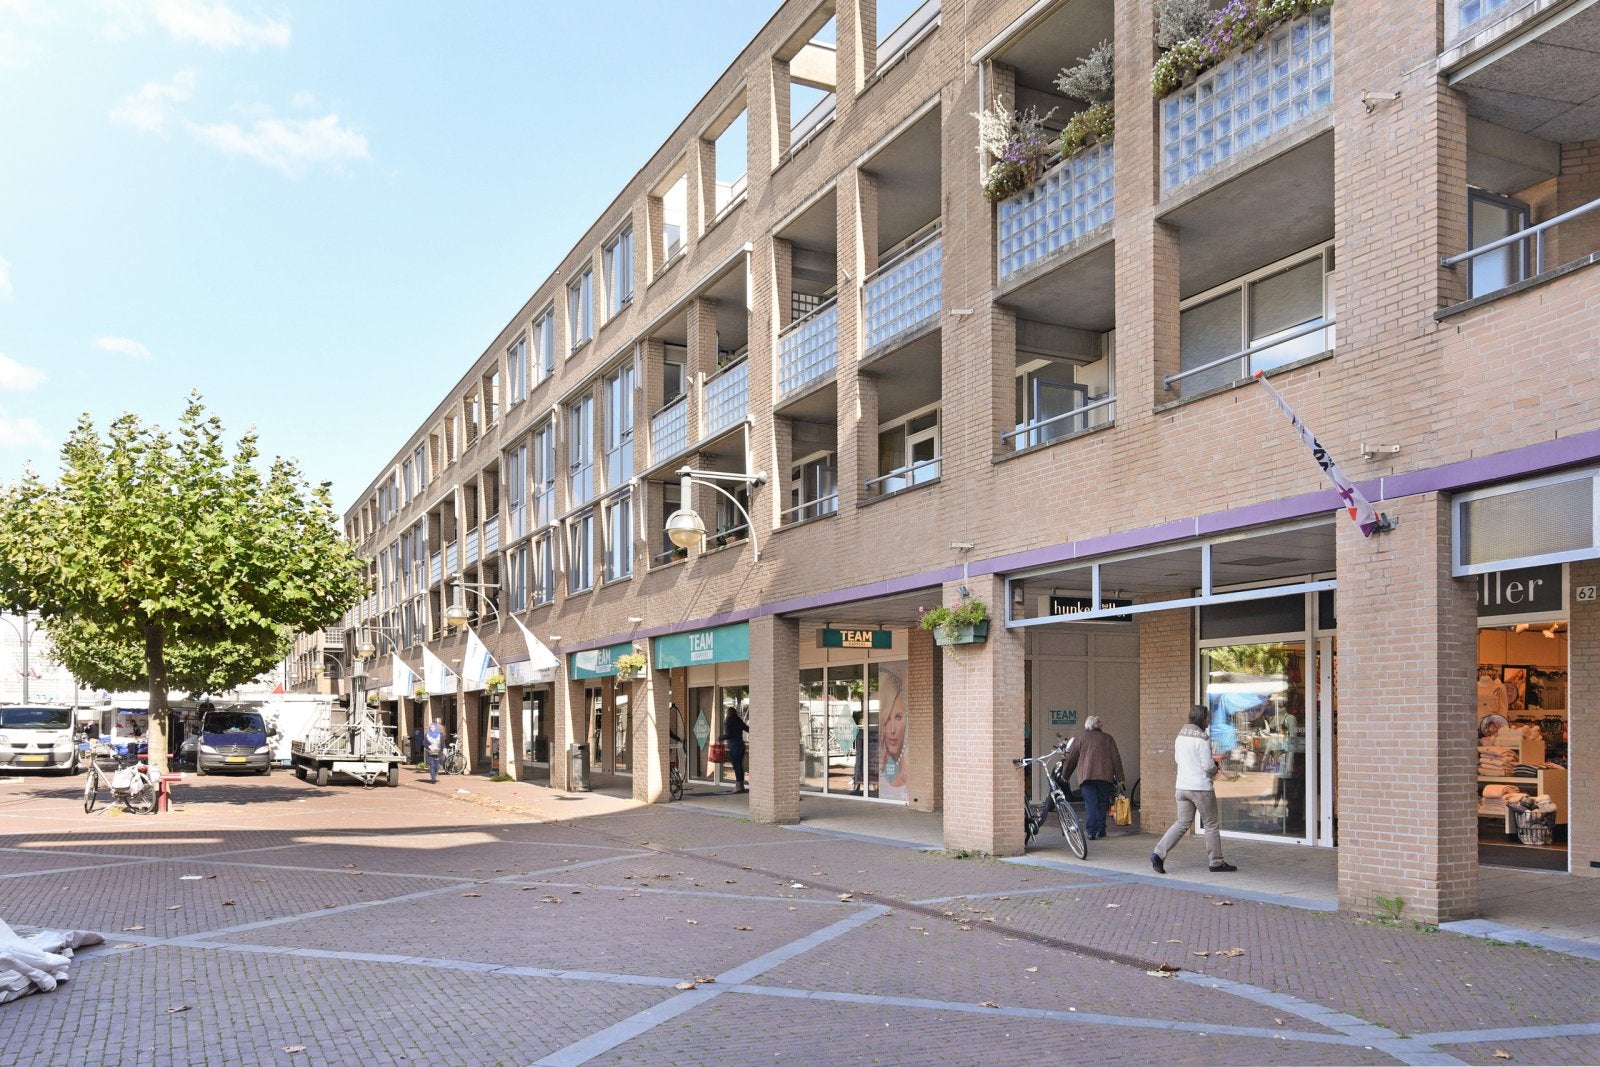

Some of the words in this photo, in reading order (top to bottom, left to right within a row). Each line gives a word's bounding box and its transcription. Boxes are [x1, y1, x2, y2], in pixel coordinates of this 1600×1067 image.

[1475, 571, 1544, 606] ller
[1579, 587, 1594, 599] 62
[689, 631, 714, 651] TEAM
[840, 630, 873, 642] TEAM
[1050, 709, 1077, 720] TEAM
